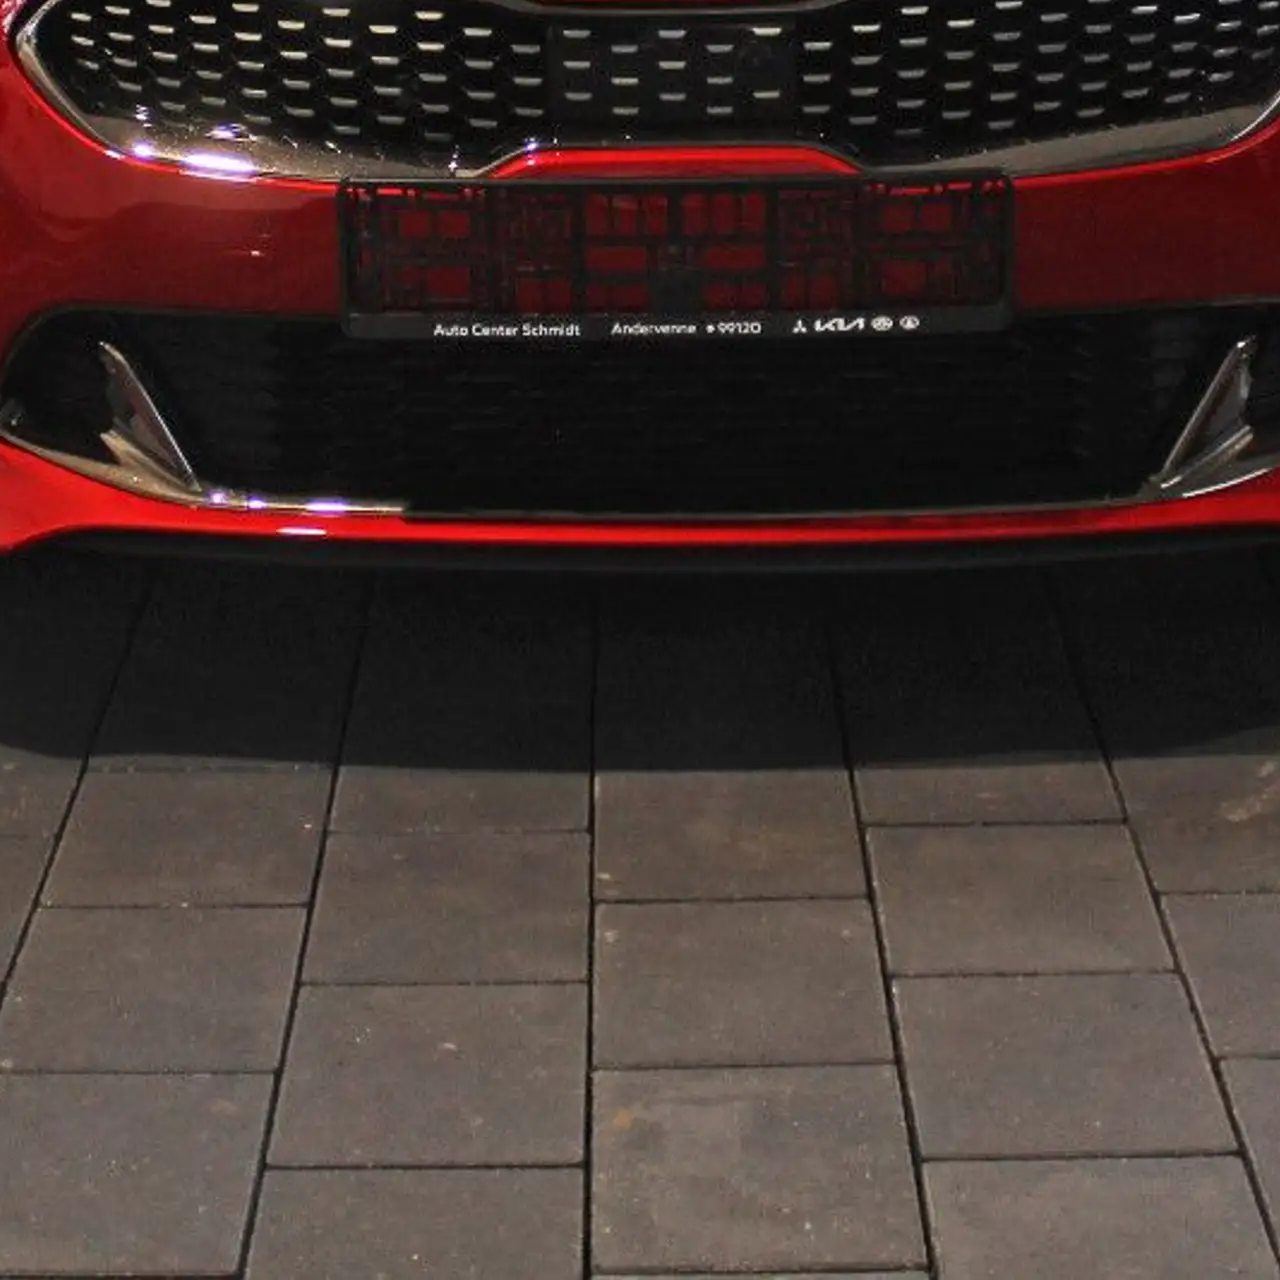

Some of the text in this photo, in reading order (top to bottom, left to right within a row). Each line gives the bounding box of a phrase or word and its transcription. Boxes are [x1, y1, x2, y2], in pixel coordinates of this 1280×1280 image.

[433, 323, 469, 337] Auto
[472, 323, 518, 337] Center
[522, 322, 581, 337] Schmidt
[611, 322, 697, 336] Andervenne
